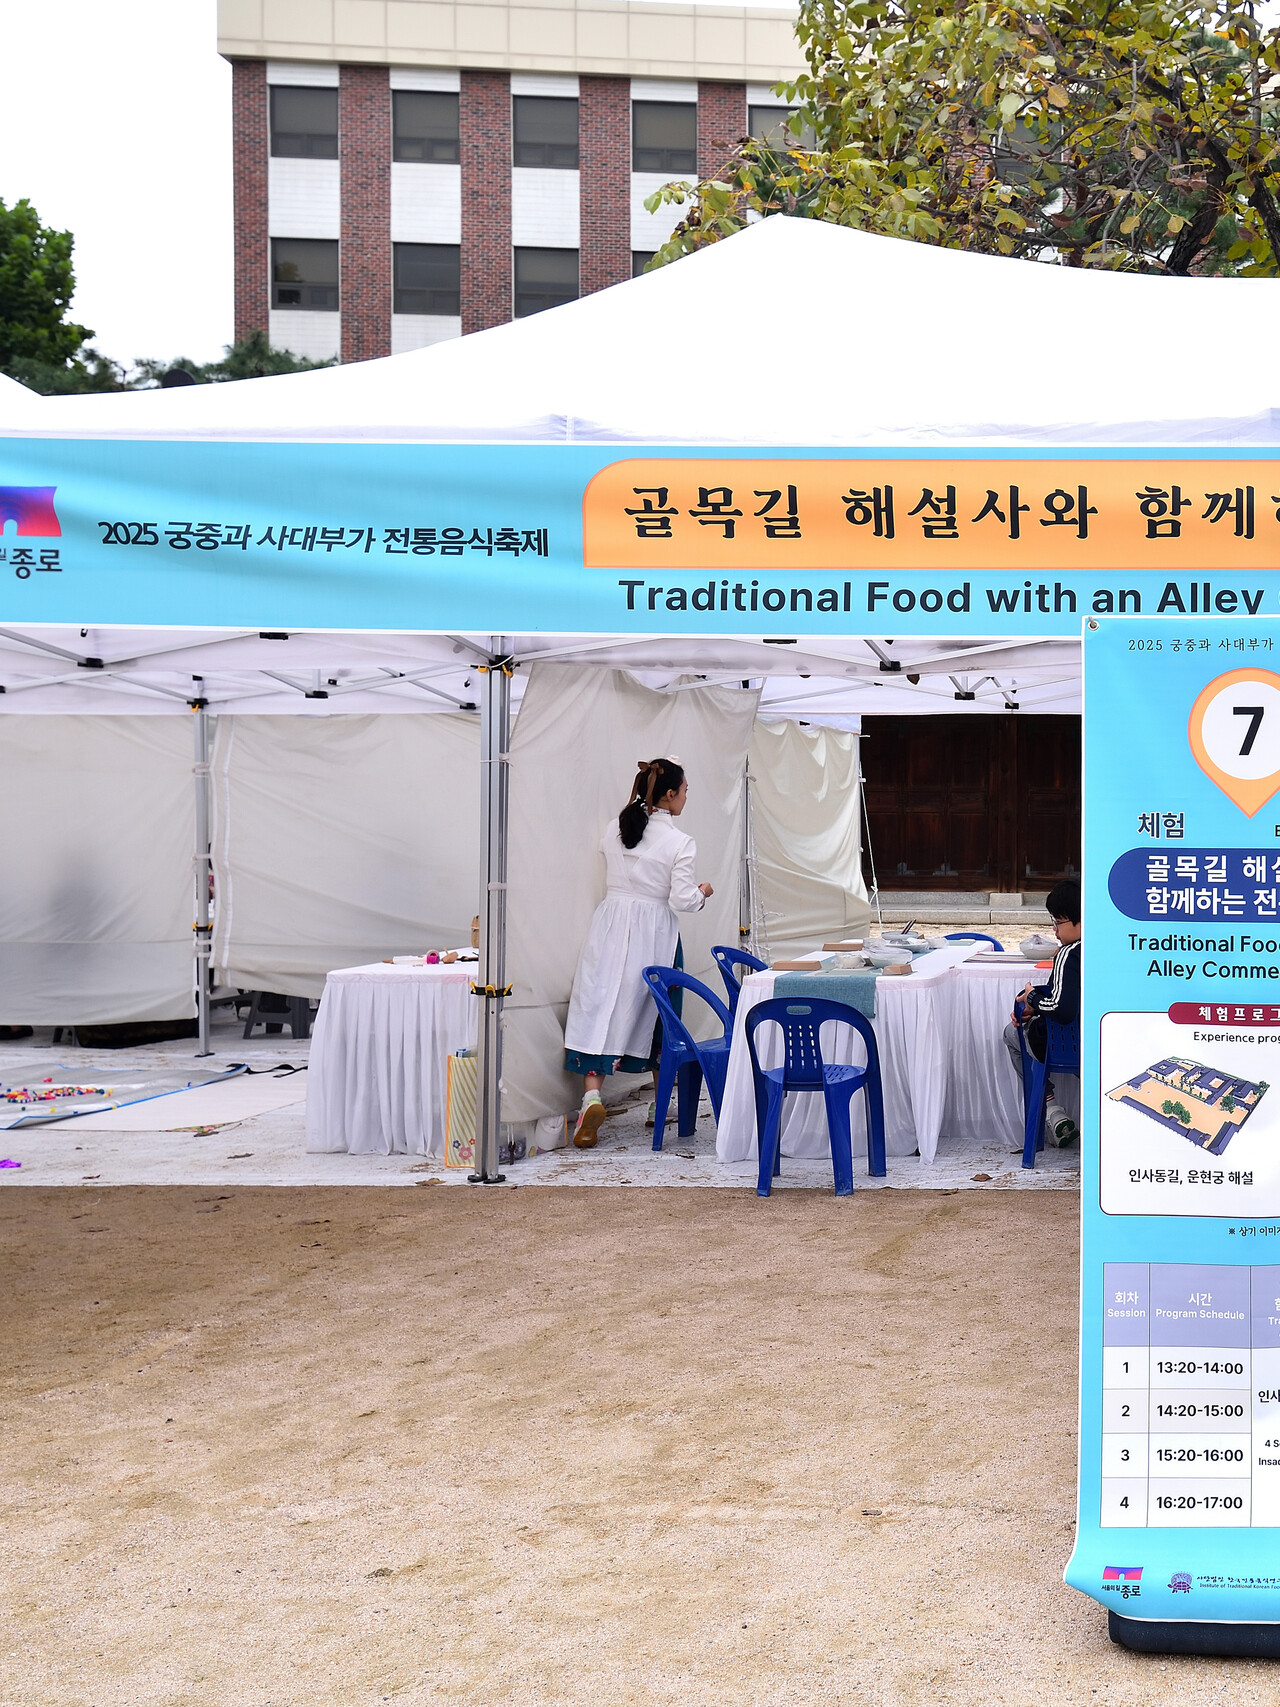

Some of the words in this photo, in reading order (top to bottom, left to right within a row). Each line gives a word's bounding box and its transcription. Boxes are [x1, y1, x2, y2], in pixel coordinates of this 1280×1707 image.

[623, 484, 802, 540] 골목길
[841, 484, 1099, 541] 해설사와
[98, 520, 159, 548] 2025
[164, 521, 253, 552] 궁중과
[257, 525, 377, 556] 사대부가
[382, 526, 550, 558] 전통음식축제
[9, 547, 63, 580] 종로
[618, 579, 852, 614] Traditional
[867, 580, 970, 614] Food
[986, 580, 1077, 615] with
[1092, 588, 1141, 615] an
[1157, 582, 1264, 615] Alley
[1128, 639, 1163, 651] 2025
[1170, 638, 1211, 652] 궁중과
[1218, 637, 1274, 652] 사대부가
[1232, 706, 1265, 756] 7
[1137, 812, 1185, 839] 체험
[1145, 855, 1228, 883] 골목길
[1145, 887, 1247, 916] 함께하는
[1128, 933, 1234, 952] Traditional
[1147, 960, 1196, 980] Alley
[1193, 1032, 1255, 1044] Experience
[1128, 1169, 1183, 1185] 인사동길,
[1187, 1170, 1224, 1185] 운현궁
[1228, 1171, 1254, 1185] 해설
[1239, 1226, 1257, 1237] 상기
[1114, 1291, 1139, 1305] 회차
[1188, 1292, 1212, 1307] 시간
[1107, 1308, 1146, 1318] Session
[1155, 1309, 1197, 1320] Program
[1199, 1309, 1245, 1320] Schedule
[1122, 1362, 1129, 1374] 1
[1157, 1361, 1243, 1375] 13:20-14:00
[1121, 1405, 1130, 1417] 2
[1157, 1404, 1243, 1418] 14:20-15:00
[1264, 1439, 1271, 1448] 4
[1121, 1449, 1130, 1462] 3
[1157, 1449, 1243, 1462] 15:20-16:00
[1120, 1496, 1130, 1509] 4
[1156, 1495, 1243, 1509] 16:20-17:00
[1121, 1585, 1141, 1599] 종로
